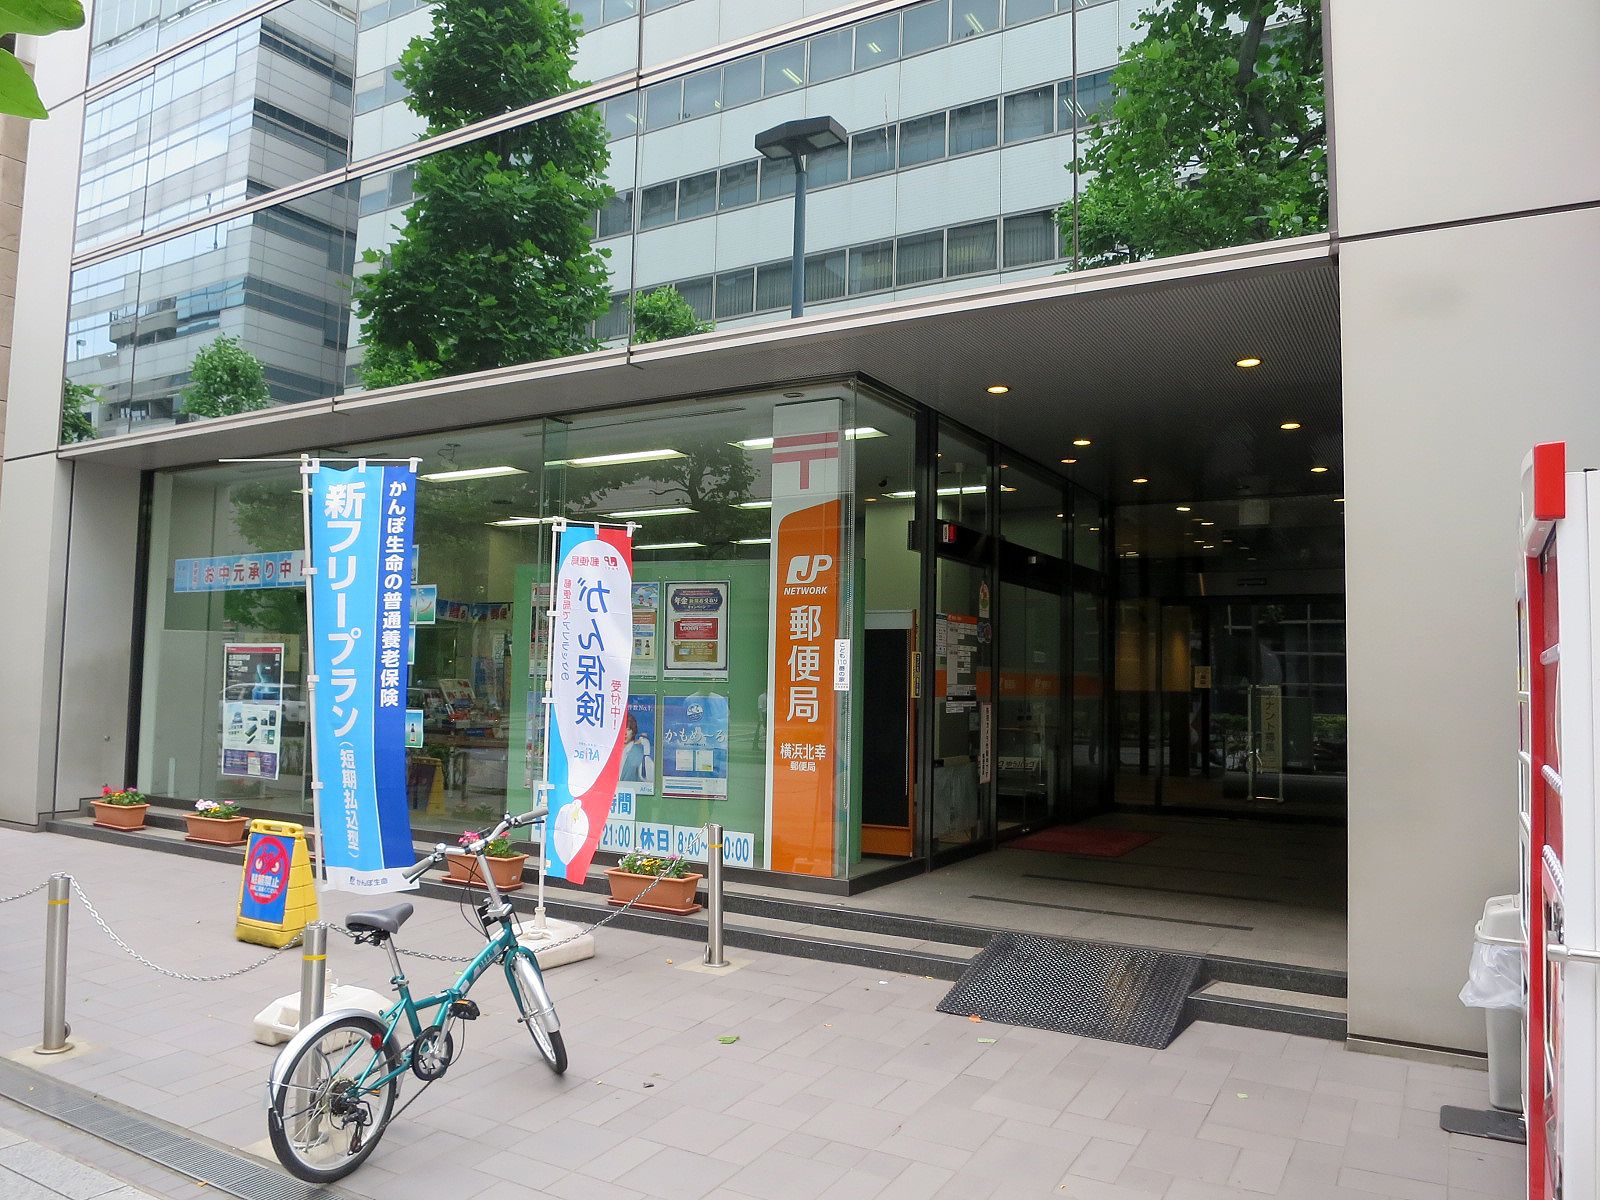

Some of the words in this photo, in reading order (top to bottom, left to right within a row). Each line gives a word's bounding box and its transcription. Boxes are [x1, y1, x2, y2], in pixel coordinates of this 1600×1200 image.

[786, 554, 833, 585] JP
[378, 480, 407, 708] かんぽ生命の普通養老保険
[784, 586, 829, 596] NETWORK
[324, 480, 367, 738] 新フリープラン
[786, 604, 823, 725] 郵便局
[780, 742, 827, 761] 横浜北幸
[789, 760, 817, 773] 郵便局
[639, 827, 669, 852] 休日
